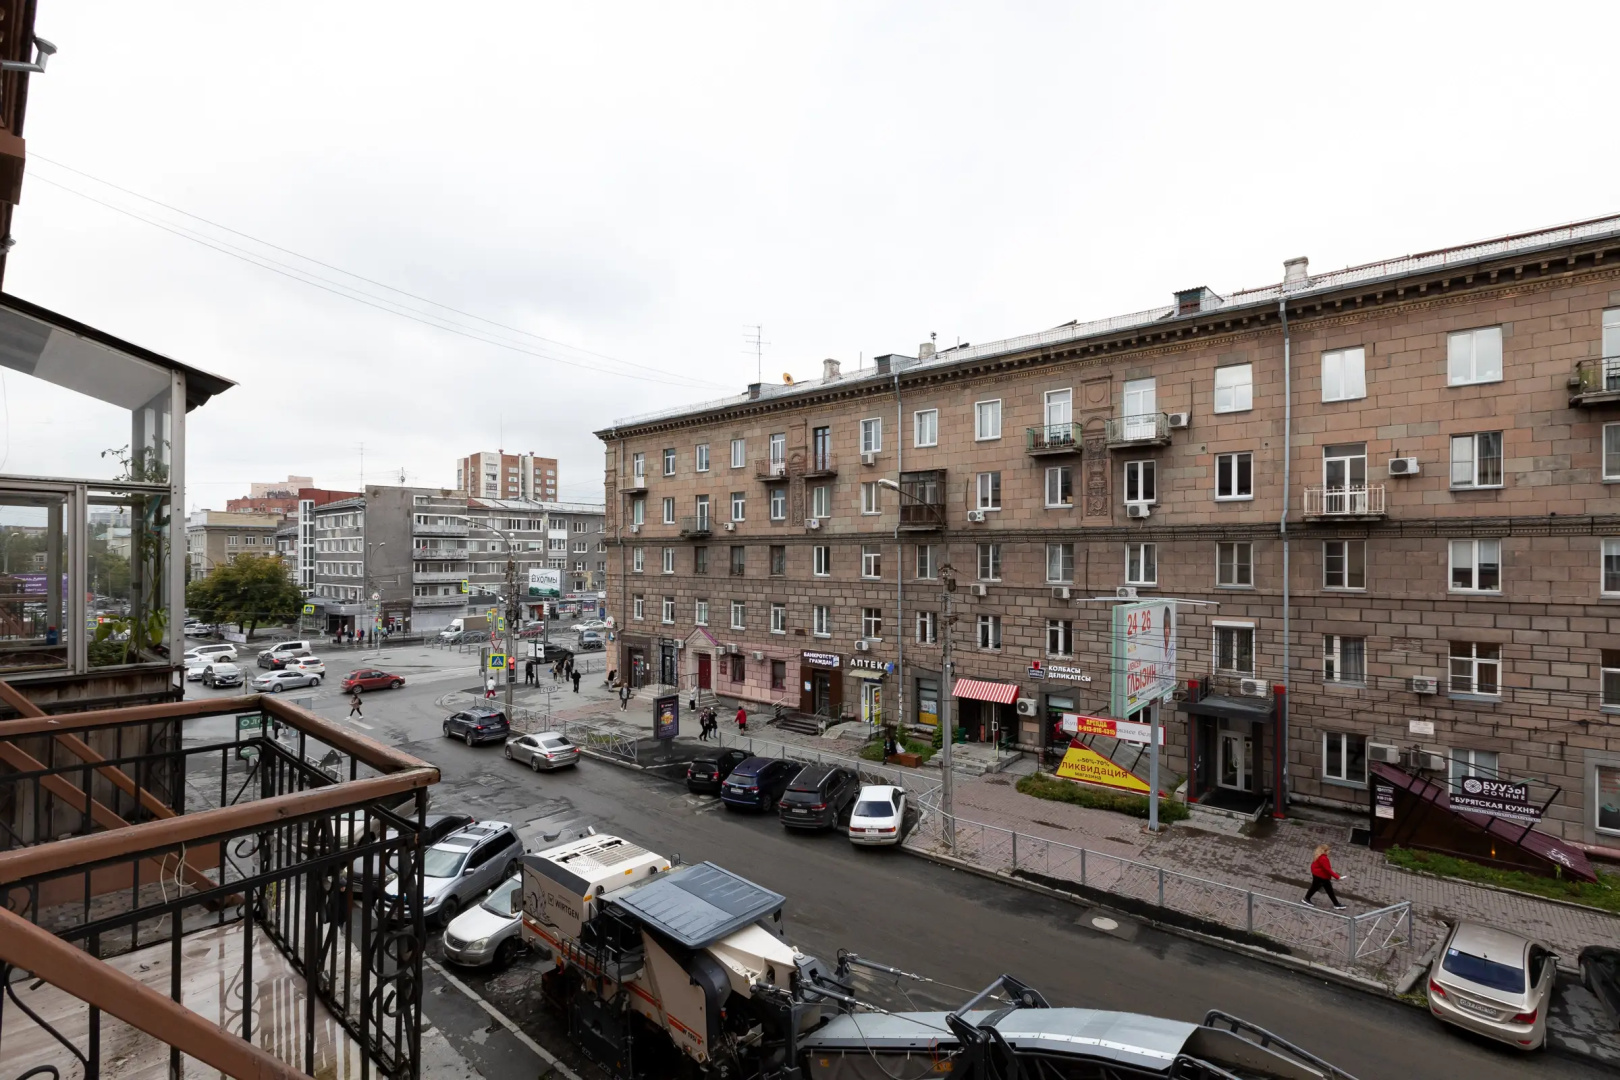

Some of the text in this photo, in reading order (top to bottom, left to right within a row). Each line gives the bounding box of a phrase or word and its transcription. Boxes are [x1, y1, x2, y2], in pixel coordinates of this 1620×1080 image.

[1127, 609, 1151, 636] 24 26
[803, 651, 835, 660] БАНКРОТСТ
[808, 658, 833, 666] ГРАЖДАН
[1048, 665, 1081, 674] КОЛБАСЫ
[1048, 672, 1092, 682] ДЕЛИКАТЕСЫ
[1127, 662, 1157, 695] ГЛЫЗИН
[1483, 789, 1526, 801] СОЧНЫЕ
[1455, 796, 1535, 814] БУРЯТСКАЯ КУХНЯ
[555, 900, 580, 920] WIRTGEN
